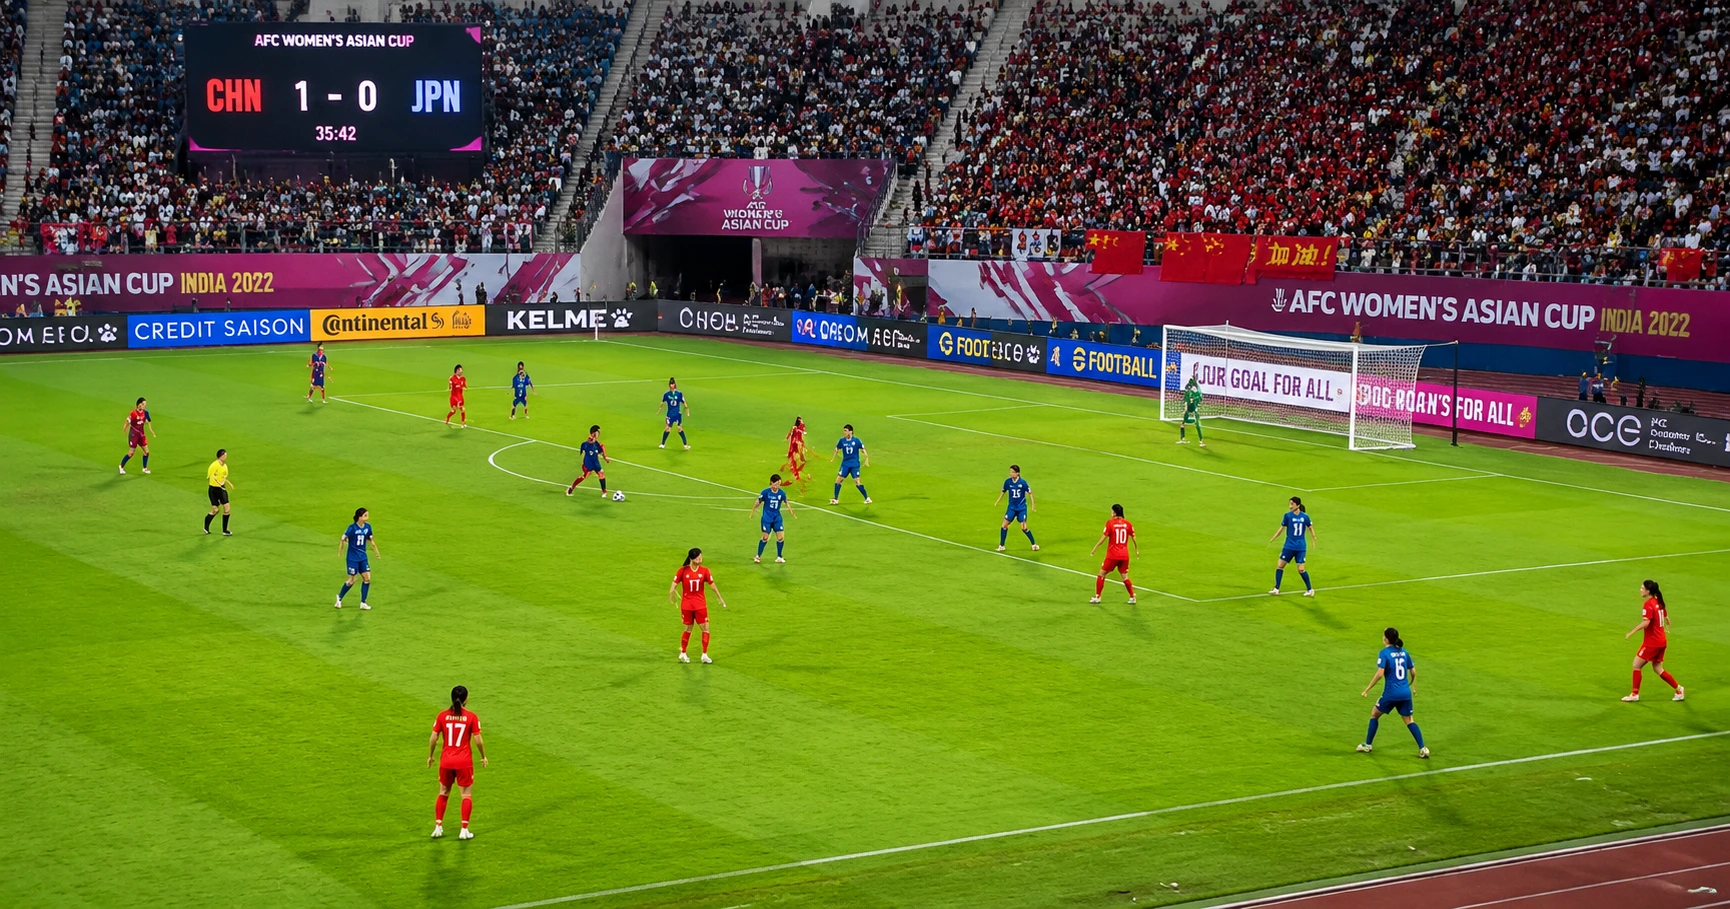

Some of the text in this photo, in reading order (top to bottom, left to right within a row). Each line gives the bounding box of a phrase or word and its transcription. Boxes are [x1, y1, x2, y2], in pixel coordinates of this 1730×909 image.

[254, 34, 414, 47] AFC WOMEN'S ASIAN CUP
[206, 78, 262, 112] CHN
[294, 80, 308, 112] 1
[358, 80, 377, 112] 0
[411, 80, 460, 112] JPN
[316, 126, 356, 141] 35:42
[722, 219, 790, 230] ASIAN CUP
[0, 272, 274, 296] N'S ASIAN CUP INDIA 2022
[322, 312, 428, 336] Continental
[507, 309, 608, 330] KELME
[1289, 290, 1690, 338] AFC WOMEN'S ASIAN CUP INDIA 2022
[135, 317, 304, 340] CREDIT SAISON
[1089, 351, 1156, 378] FOOTBALL
[1231, 368, 1269, 393] GOAL
[1274, 373, 1300, 397] FOR
[1306, 378, 1334, 402] ALL
[1456, 397, 1482, 422] FOR
[1488, 401, 1514, 426] ALL
[1116, 528, 1127, 544] 10
[446, 722, 466, 747] 17
